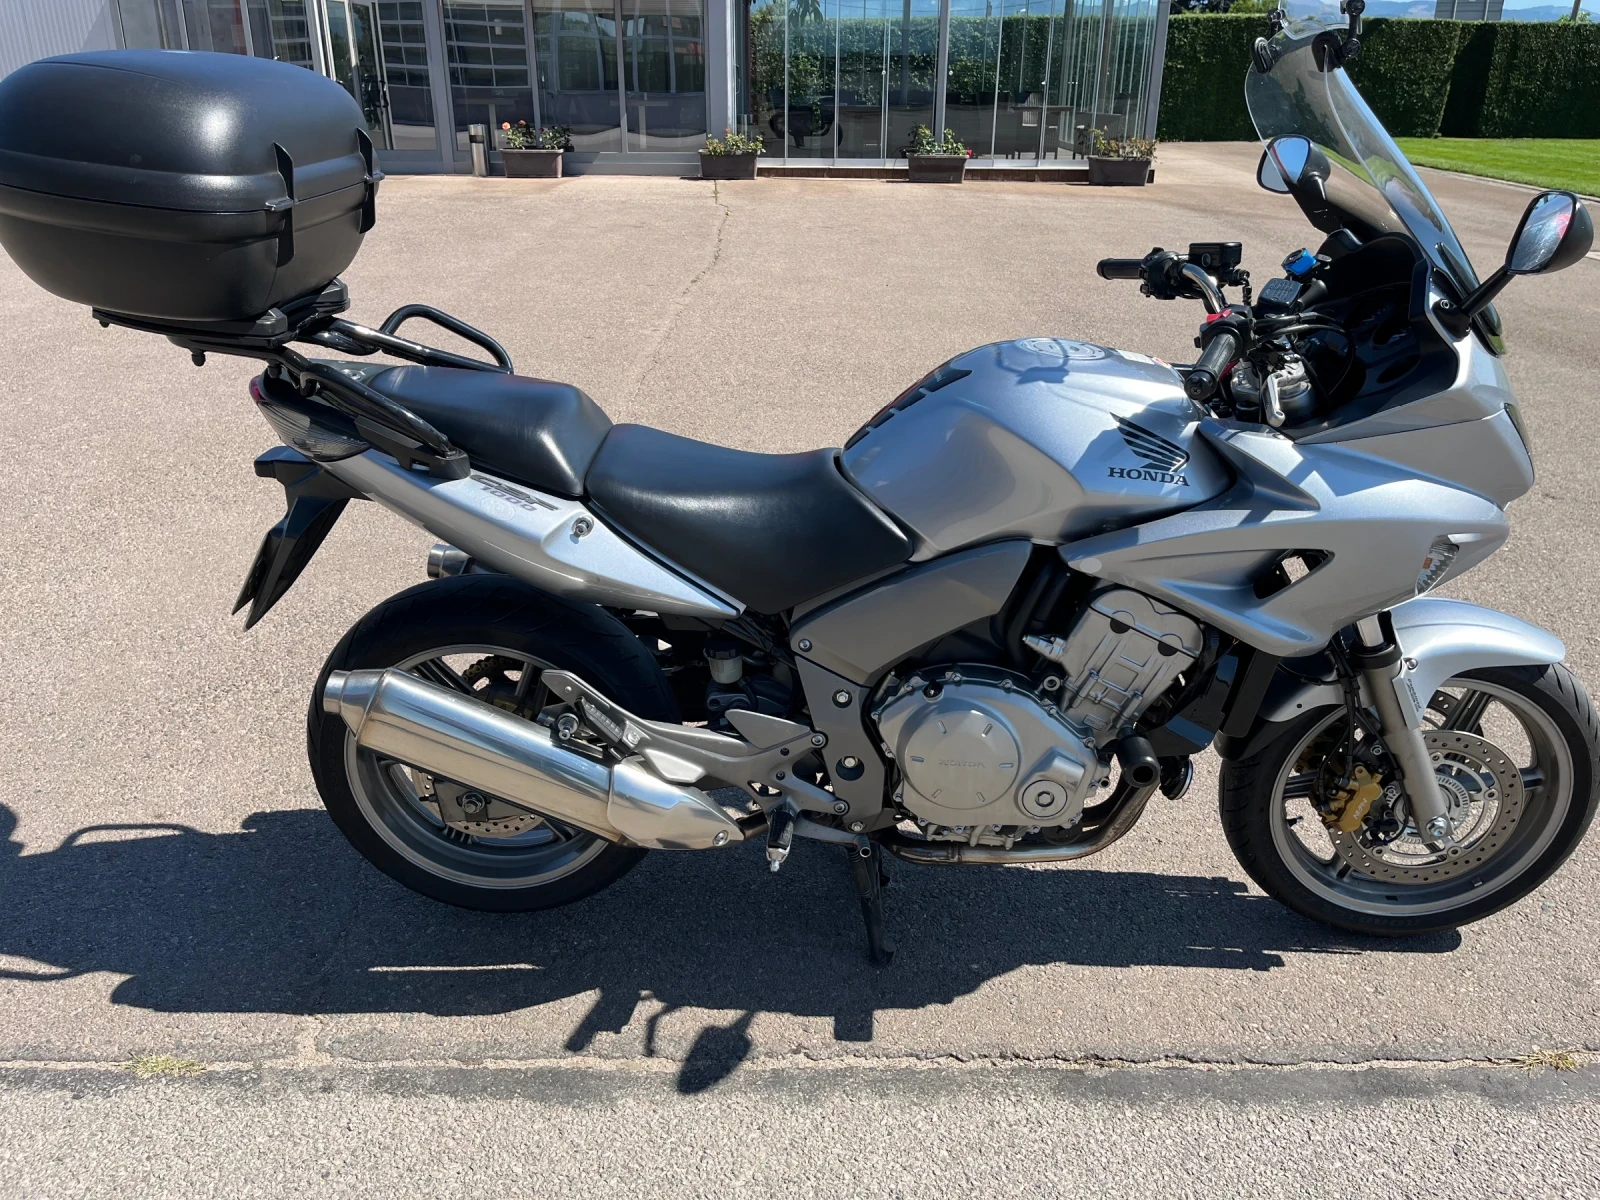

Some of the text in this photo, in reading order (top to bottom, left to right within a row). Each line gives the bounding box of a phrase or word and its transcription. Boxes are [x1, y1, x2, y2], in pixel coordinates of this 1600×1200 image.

[1107, 466, 1190, 487] HONDA
[481, 485, 537, 512] 1000
[938, 759, 986, 769] HONDA
